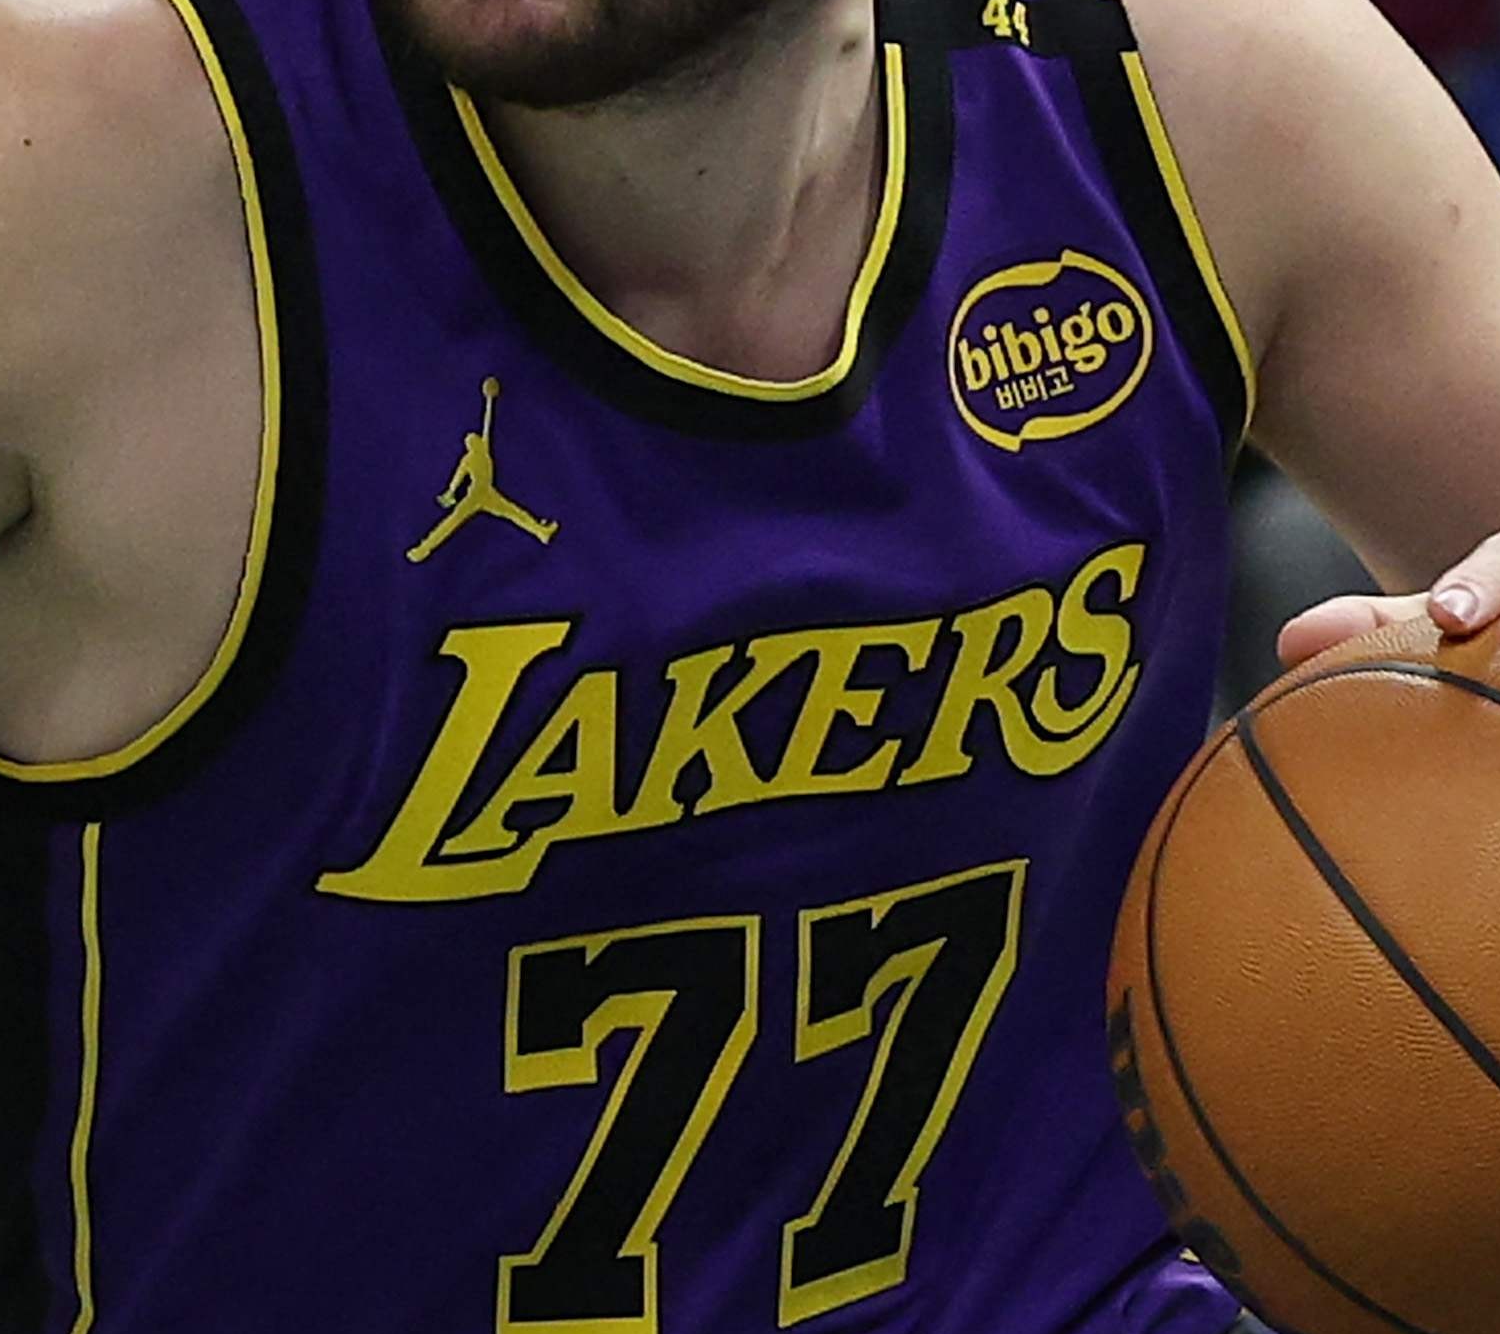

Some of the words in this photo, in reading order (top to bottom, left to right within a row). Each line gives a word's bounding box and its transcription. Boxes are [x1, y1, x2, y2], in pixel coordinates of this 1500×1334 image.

[957, 300, 1136, 391] bibigo
[995, 365, 1076, 410] 비비고
[312, 542, 1147, 904] LAKERS
